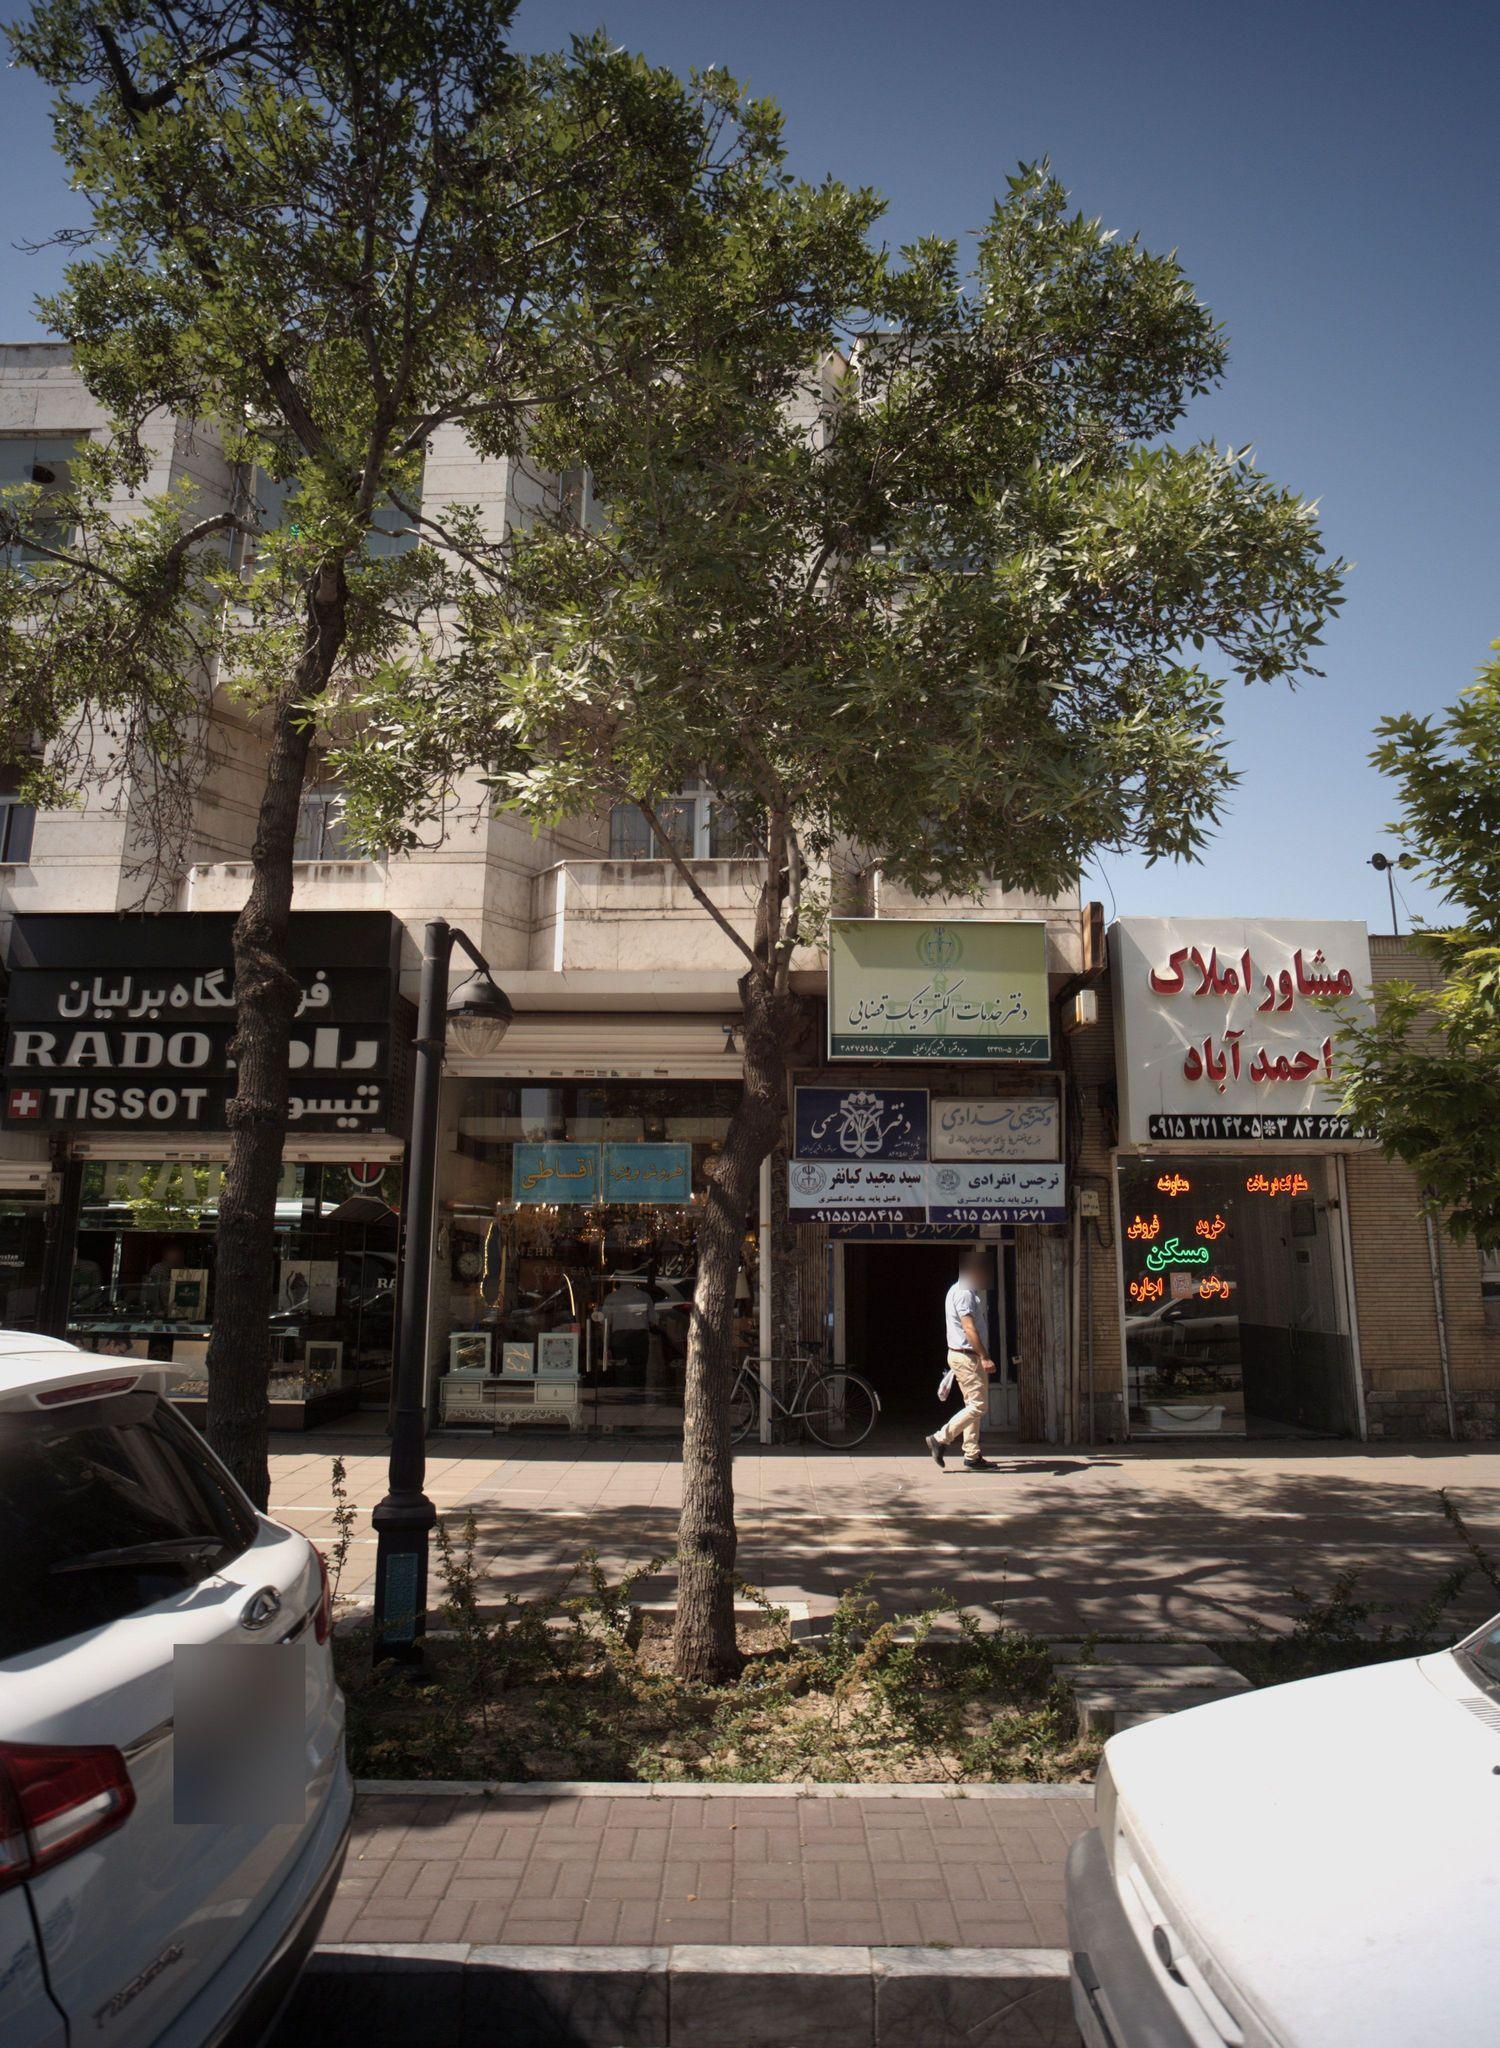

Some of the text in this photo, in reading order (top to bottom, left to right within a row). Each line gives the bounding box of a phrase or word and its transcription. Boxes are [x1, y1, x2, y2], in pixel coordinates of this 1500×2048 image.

[1150, 946, 1354, 1012] مشاور املاک
[57, 968, 331, 1020] فرگاه برلیان
[885, 979, 964, 1031] الکترونیک
[956, 999, 1002, 1021] خدمات
[999, 993, 1028, 1026] دفتر
[9, 1030, 211, 1069] RADO
[1183, 1029, 1334, 1095] احمد آباد
[49, 1088, 208, 1120] TISSOT
[1023, 1104, 1055, 1129] دکتر
[881, 1102, 912, 1137] دفتر
[1151, 1117, 1262, 1138] ۰۹۱۵ ۳۲۱ ۴۲۰۵
[1292, 1117, 1314, 1138] ۸۴
[1318, 1117, 1349, 1138] ۶۶۶
[521, 1157, 593, 1190] اقساطی
[828, 1168, 921, 1190] سید مجید کیانفر
[968, 1172, 1060, 1189] نرجس انفرادی
[1021, 1196, 1039, 1204] وکیل
[810, 1210, 904, 1222] ۰۹۱۵۵۱۵۸۴۱۵
[946, 1209, 1046, 1221] ۰۹۱۵ ۵۸۱ ۱۶۷۱
[1127, 1213, 1160, 1239] فروش
[1195, 1213, 1226, 1240] خرید
[1146, 1237, 1210, 1272] مسکن
[1129, 1276, 1164, 1302] اجاره
[1199, 1275, 1230, 1300] رهن
